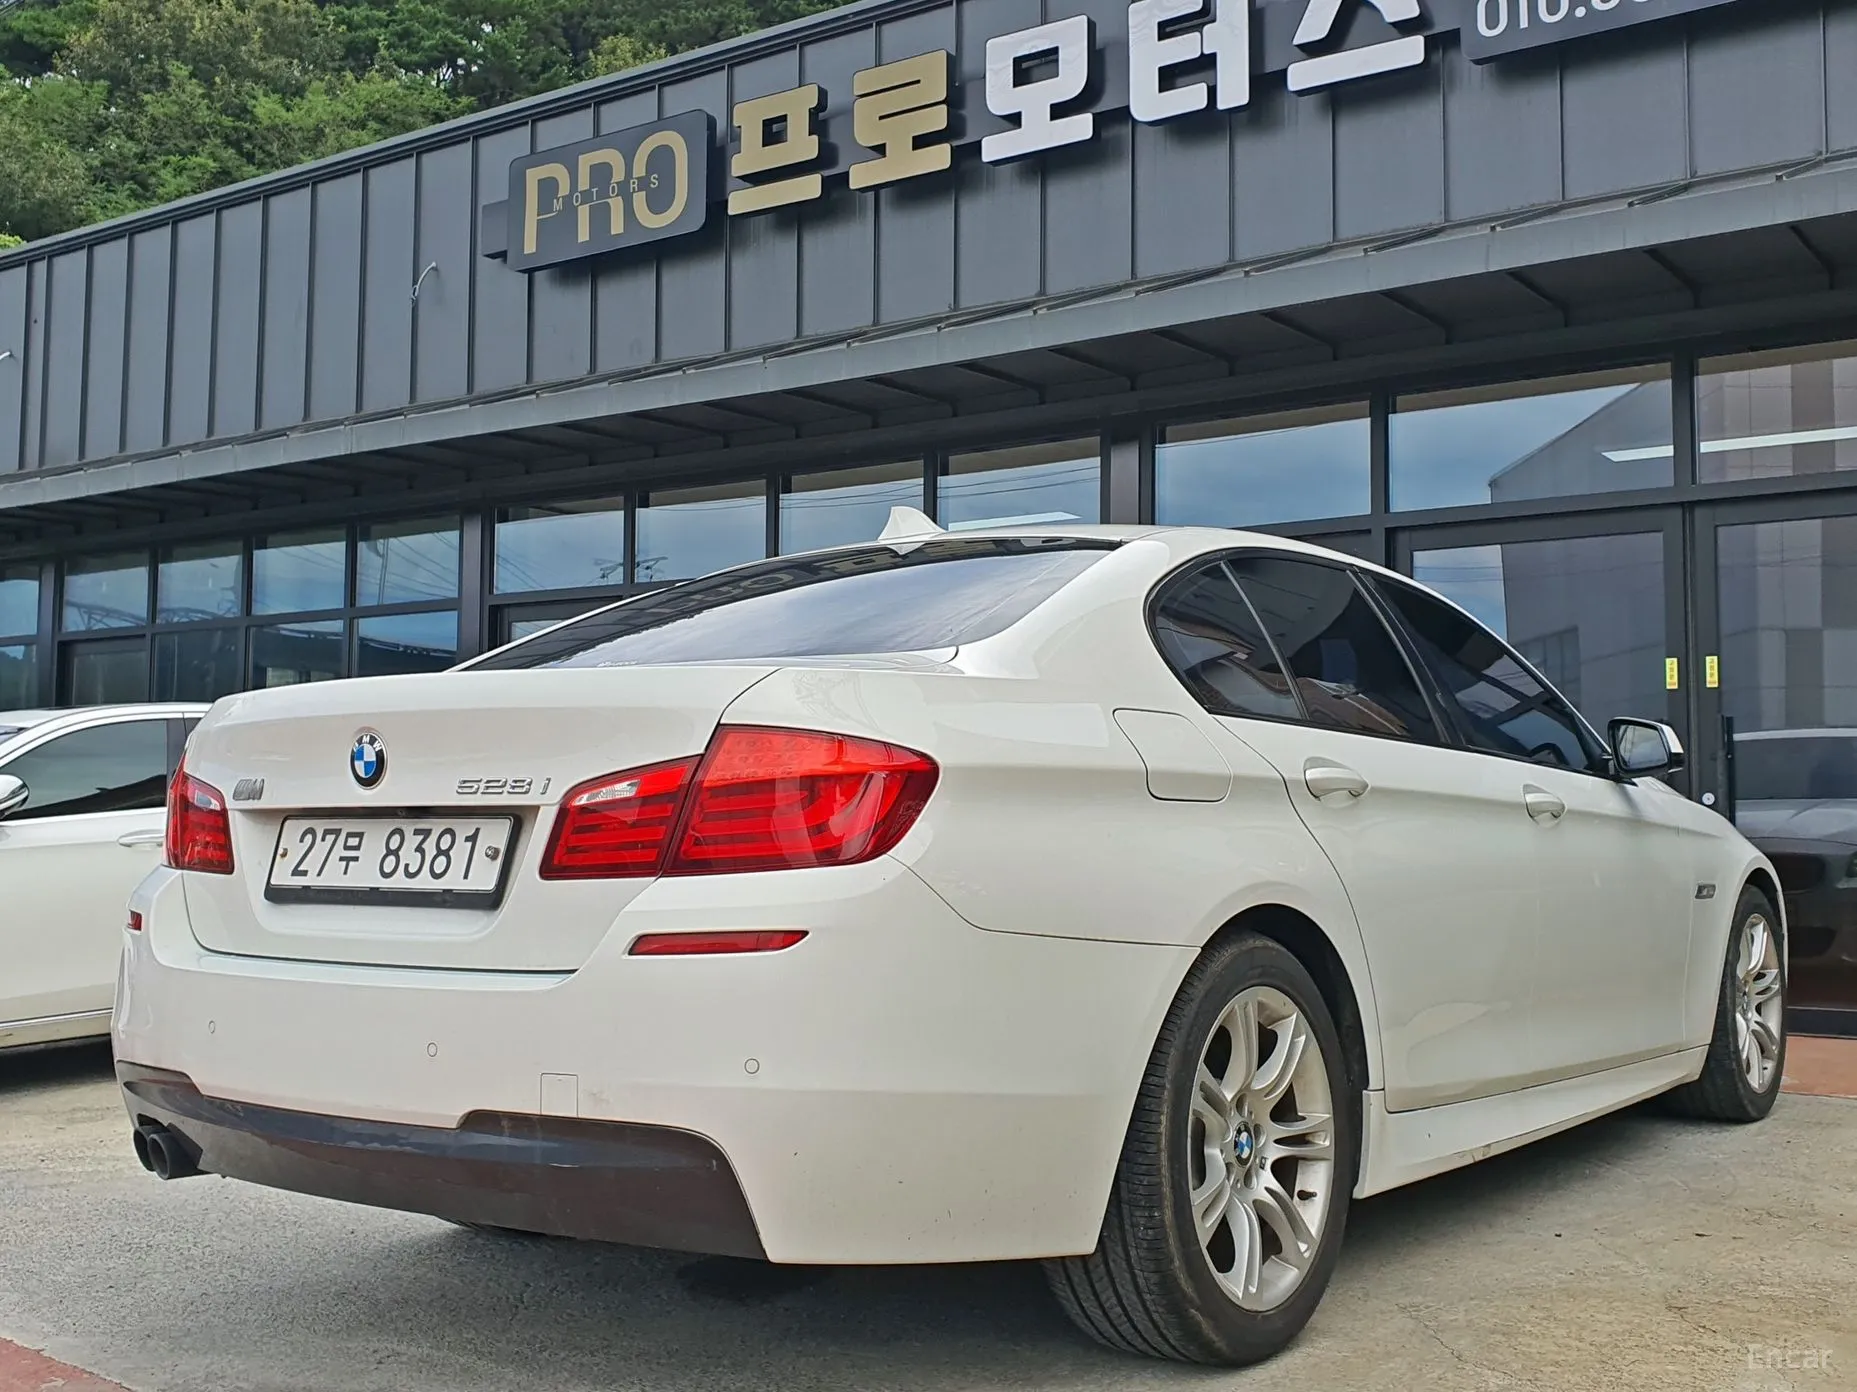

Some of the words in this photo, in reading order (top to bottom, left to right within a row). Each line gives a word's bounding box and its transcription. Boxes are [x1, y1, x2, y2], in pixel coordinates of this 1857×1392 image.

[523, 130, 689, 255] PRO
[552, 173, 659, 212] MOTORS
[290, 826, 366, 879] 27무
[378, 827, 482, 881] 8381
